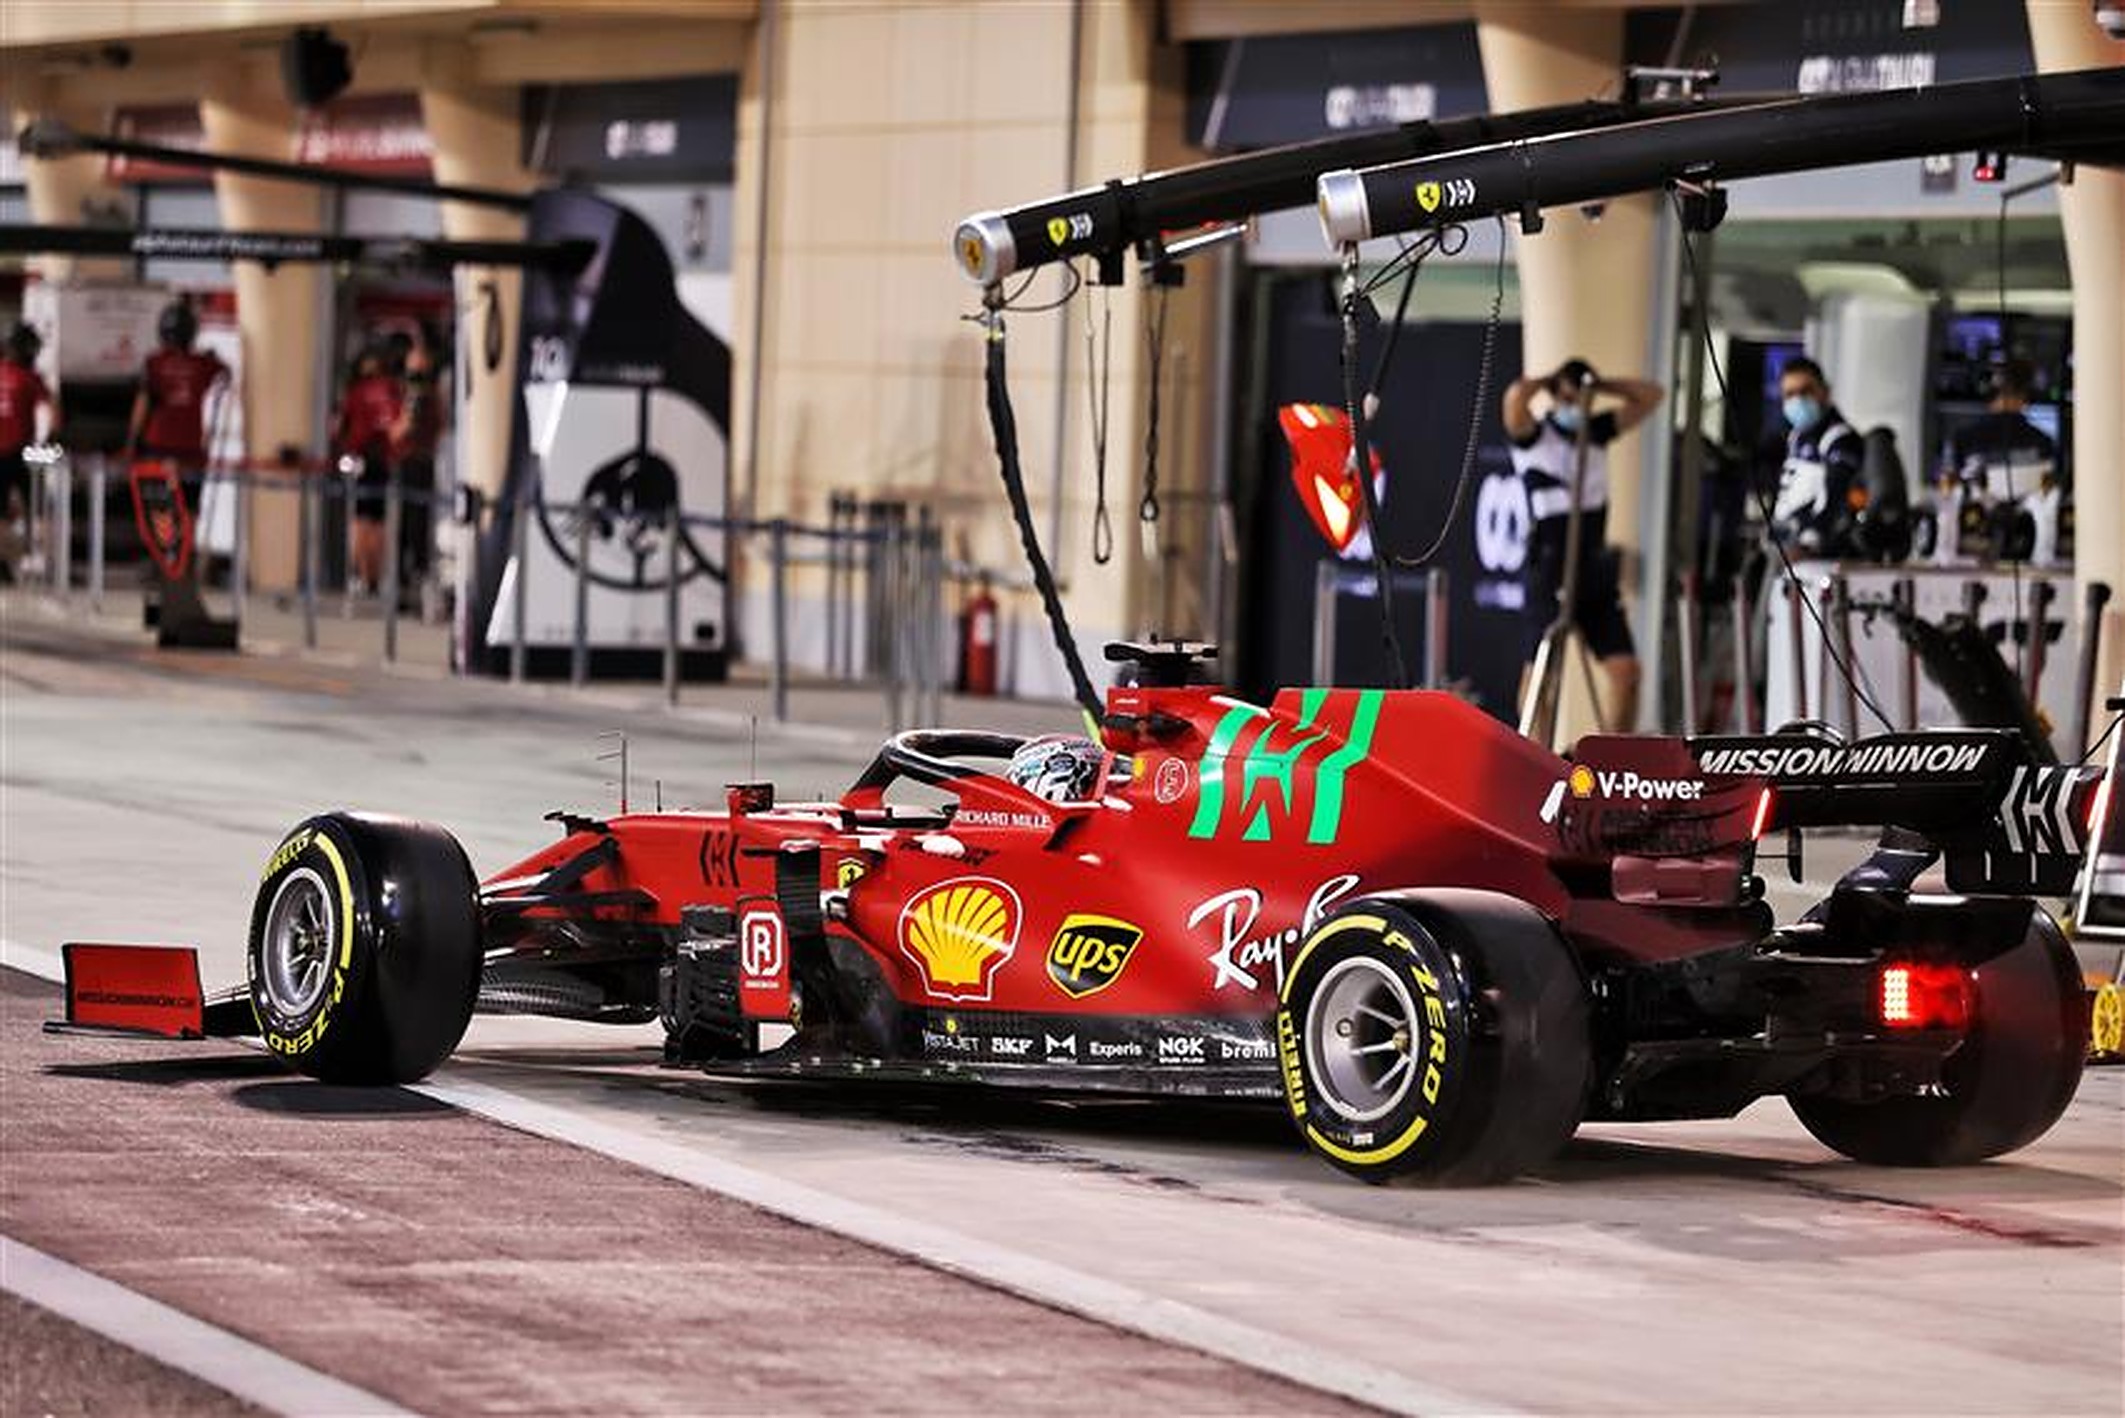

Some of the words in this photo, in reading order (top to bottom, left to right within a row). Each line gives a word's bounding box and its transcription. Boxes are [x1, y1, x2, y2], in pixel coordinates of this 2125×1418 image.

[1700, 749, 1845, 776] MISSION
[1598, 772, 1705, 799] V-Power
[955, 810, 1008, 827] RICHARD
[1012, 813, 1051, 829] MILLE
[1055, 932, 1127, 982] ups
[268, 1006, 331, 1055] ZERO
[1411, 962, 1447, 1105] ZERO
[1089, 1041, 1143, 1060] Experis
[1158, 1037, 1205, 1057] NGK
